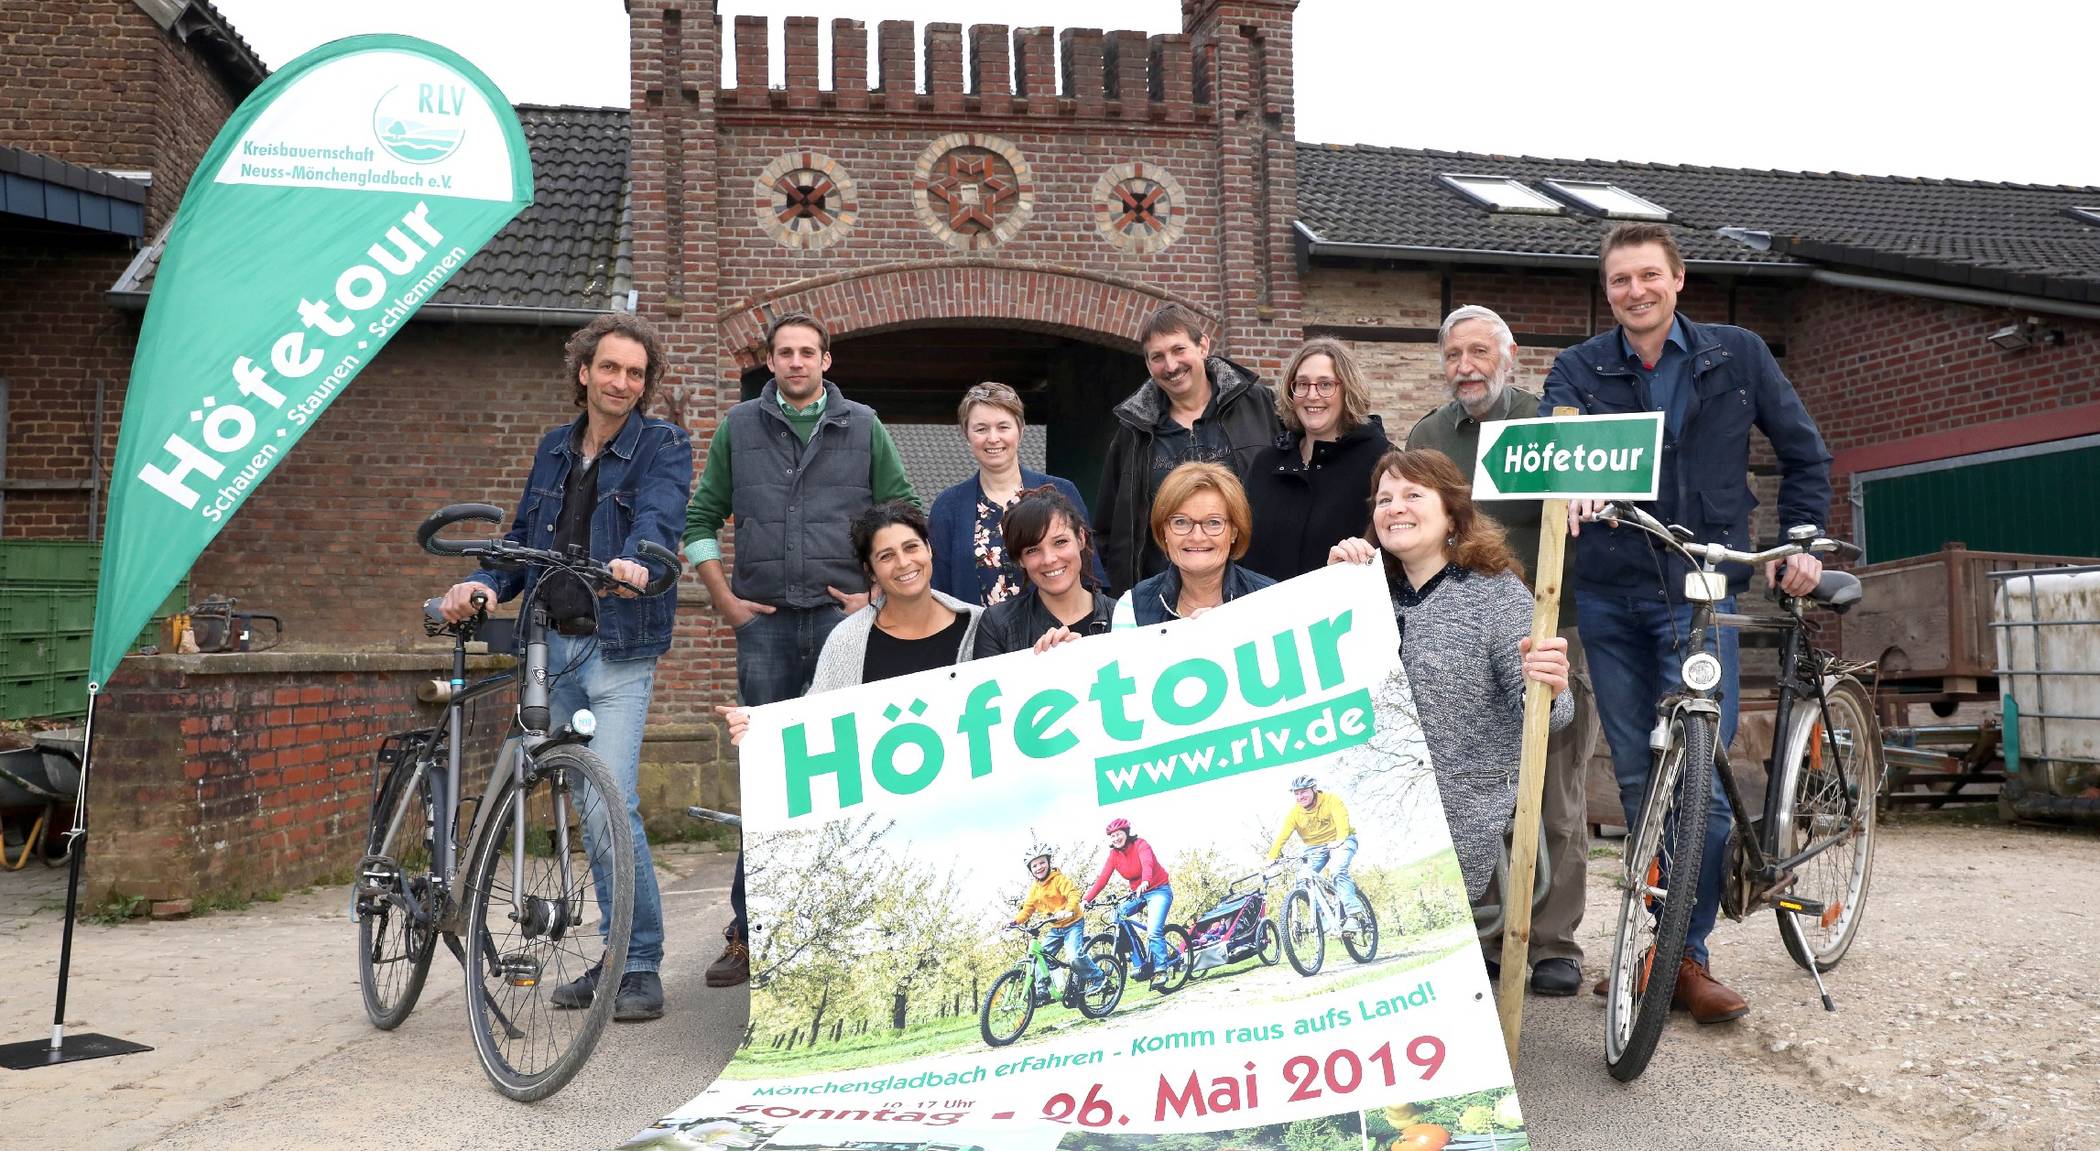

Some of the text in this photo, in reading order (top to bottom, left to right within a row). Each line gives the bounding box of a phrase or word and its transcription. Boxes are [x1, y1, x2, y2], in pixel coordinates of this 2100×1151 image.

[418, 82, 466, 116] RLV
[240, 163, 452, 189] Neuss-Mönchengladbach e.V.
[243, 141, 374, 162] Kreisbauernschaft
[137, 200, 444, 510] Höfetour
[202, 246, 466, 522] Schauen Staunen Schlemmen
[1504, 441, 1643, 473] Höfetour
[781, 608, 1354, 819] Höfetour
[1105, 705, 1369, 793] www.rlv.de
[752, 1065, 987, 1096] Mönchengladbach
[995, 1049, 1102, 1077] erFahren
[1131, 1028, 1215, 1057] Komm
[1225, 1021, 1284, 1044] raus
[1293, 1007, 1352, 1036] aufs
[1359, 980, 1437, 1021] Land!
[1039, 1083, 1131, 1127] 26.
[1154, 1060, 1258, 1122] Mai
[1282, 1035, 1446, 1103] 2019
